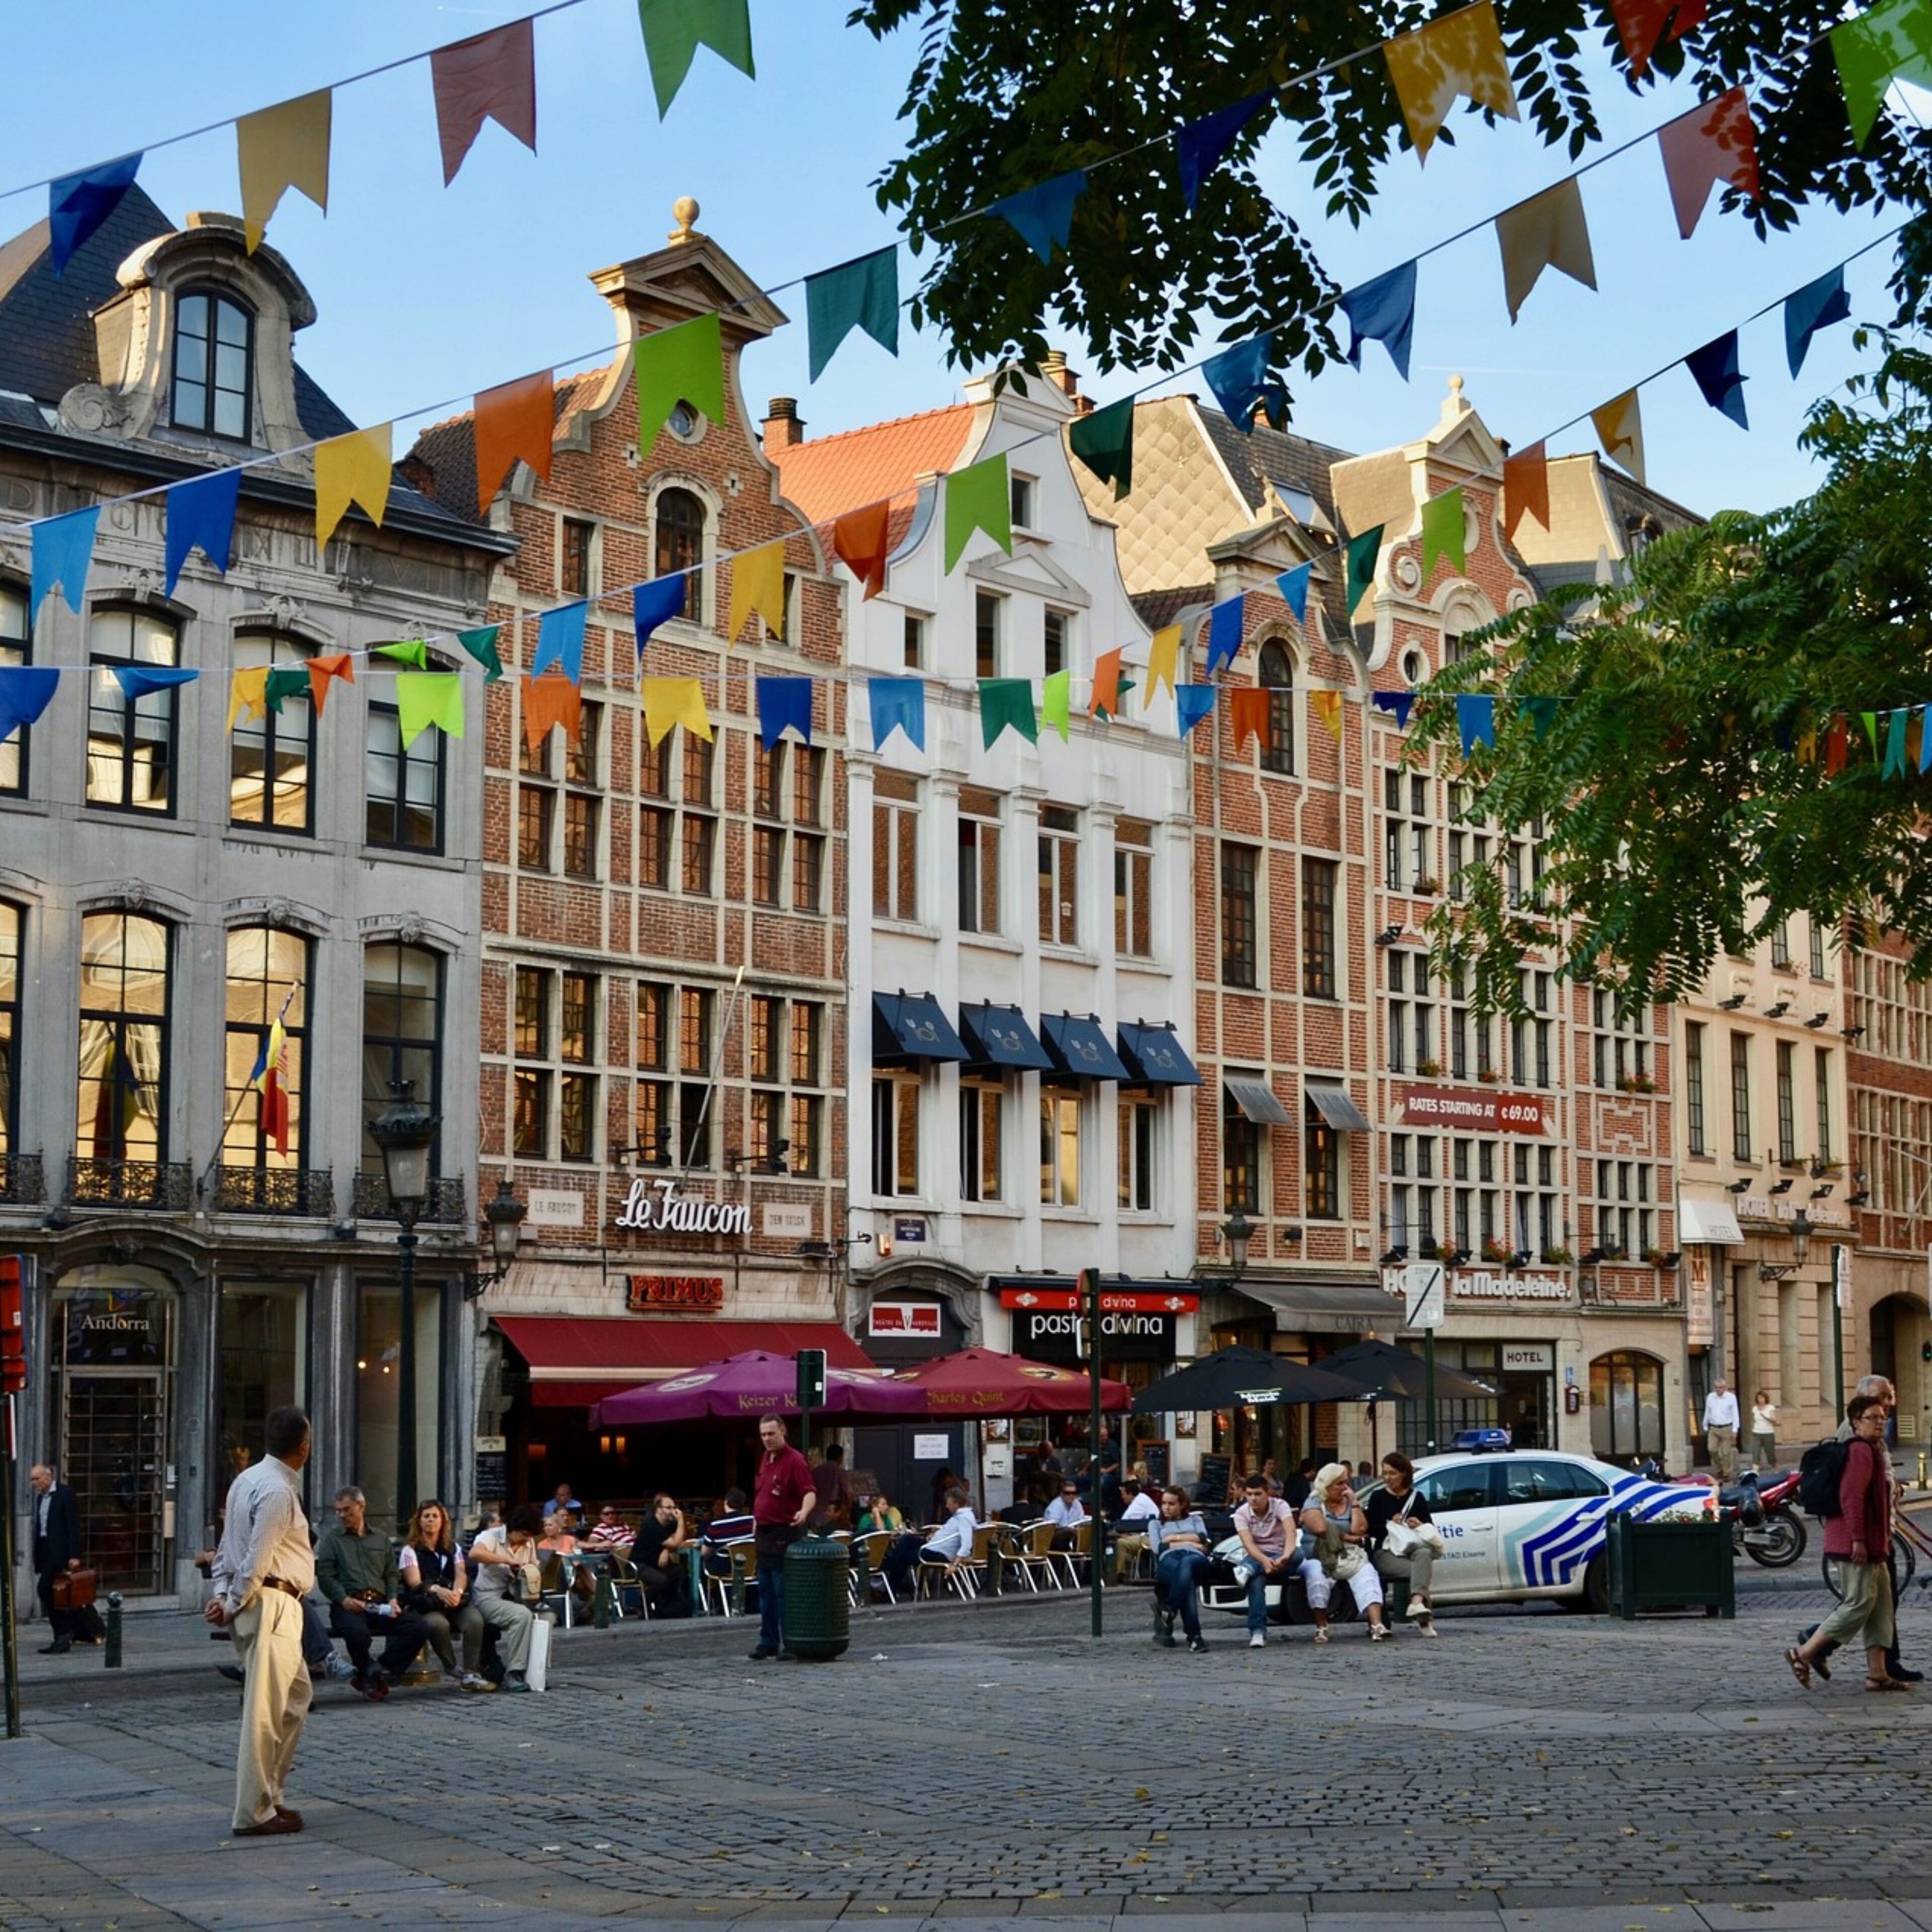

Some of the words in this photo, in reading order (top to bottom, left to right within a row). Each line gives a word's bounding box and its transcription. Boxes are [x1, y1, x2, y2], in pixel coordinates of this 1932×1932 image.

[1409, 1097, 1437, 1112] RATES
[1439, 1100, 1483, 1116] STARTING
[1484, 1104, 1496, 1117] AT
[615, 1179, 651, 1228] Le
[653, 1180, 753, 1234] Faucon
[630, 1275, 723, 1303] PRIMUS
[82, 1314, 149, 1330] Andorra
[1101, 1311, 1163, 1335] divina
[1506, 1352, 1544, 1363] HOTEL
